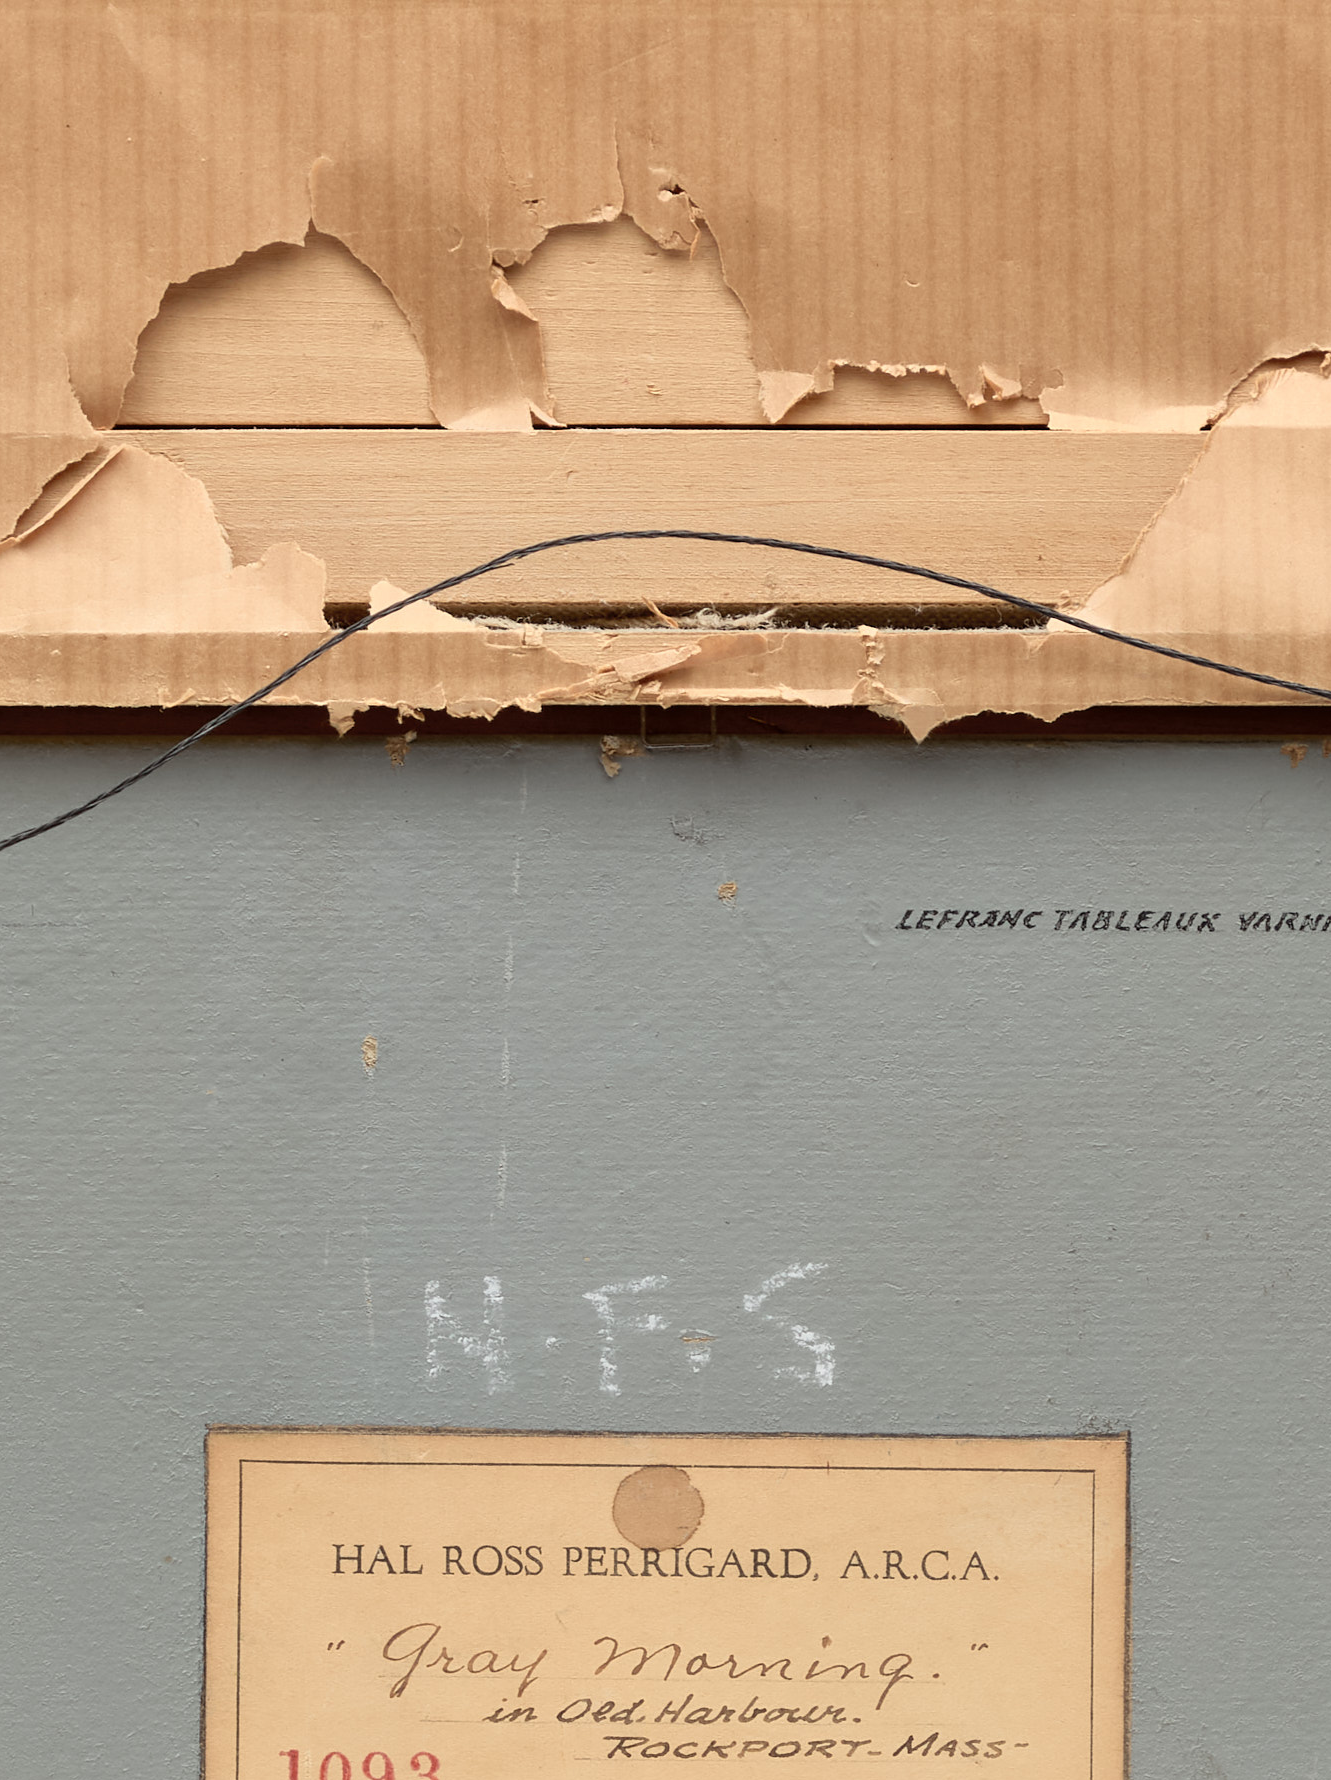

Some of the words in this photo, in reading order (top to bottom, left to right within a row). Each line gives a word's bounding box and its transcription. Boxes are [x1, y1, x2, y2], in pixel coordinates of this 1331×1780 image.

[894, 908, 1044, 931] LEFRANC
[1053, 909, 1222, 932] TABLEAUX
[330, 1544, 424, 1577] HAL
[441, 1545, 544, 1577] ROSS
[561, 1546, 820, 1582] PERRIGARD,
[839, 1549, 1001, 1582] A.R.C.A.
[482, 1697, 537, 1723] in
